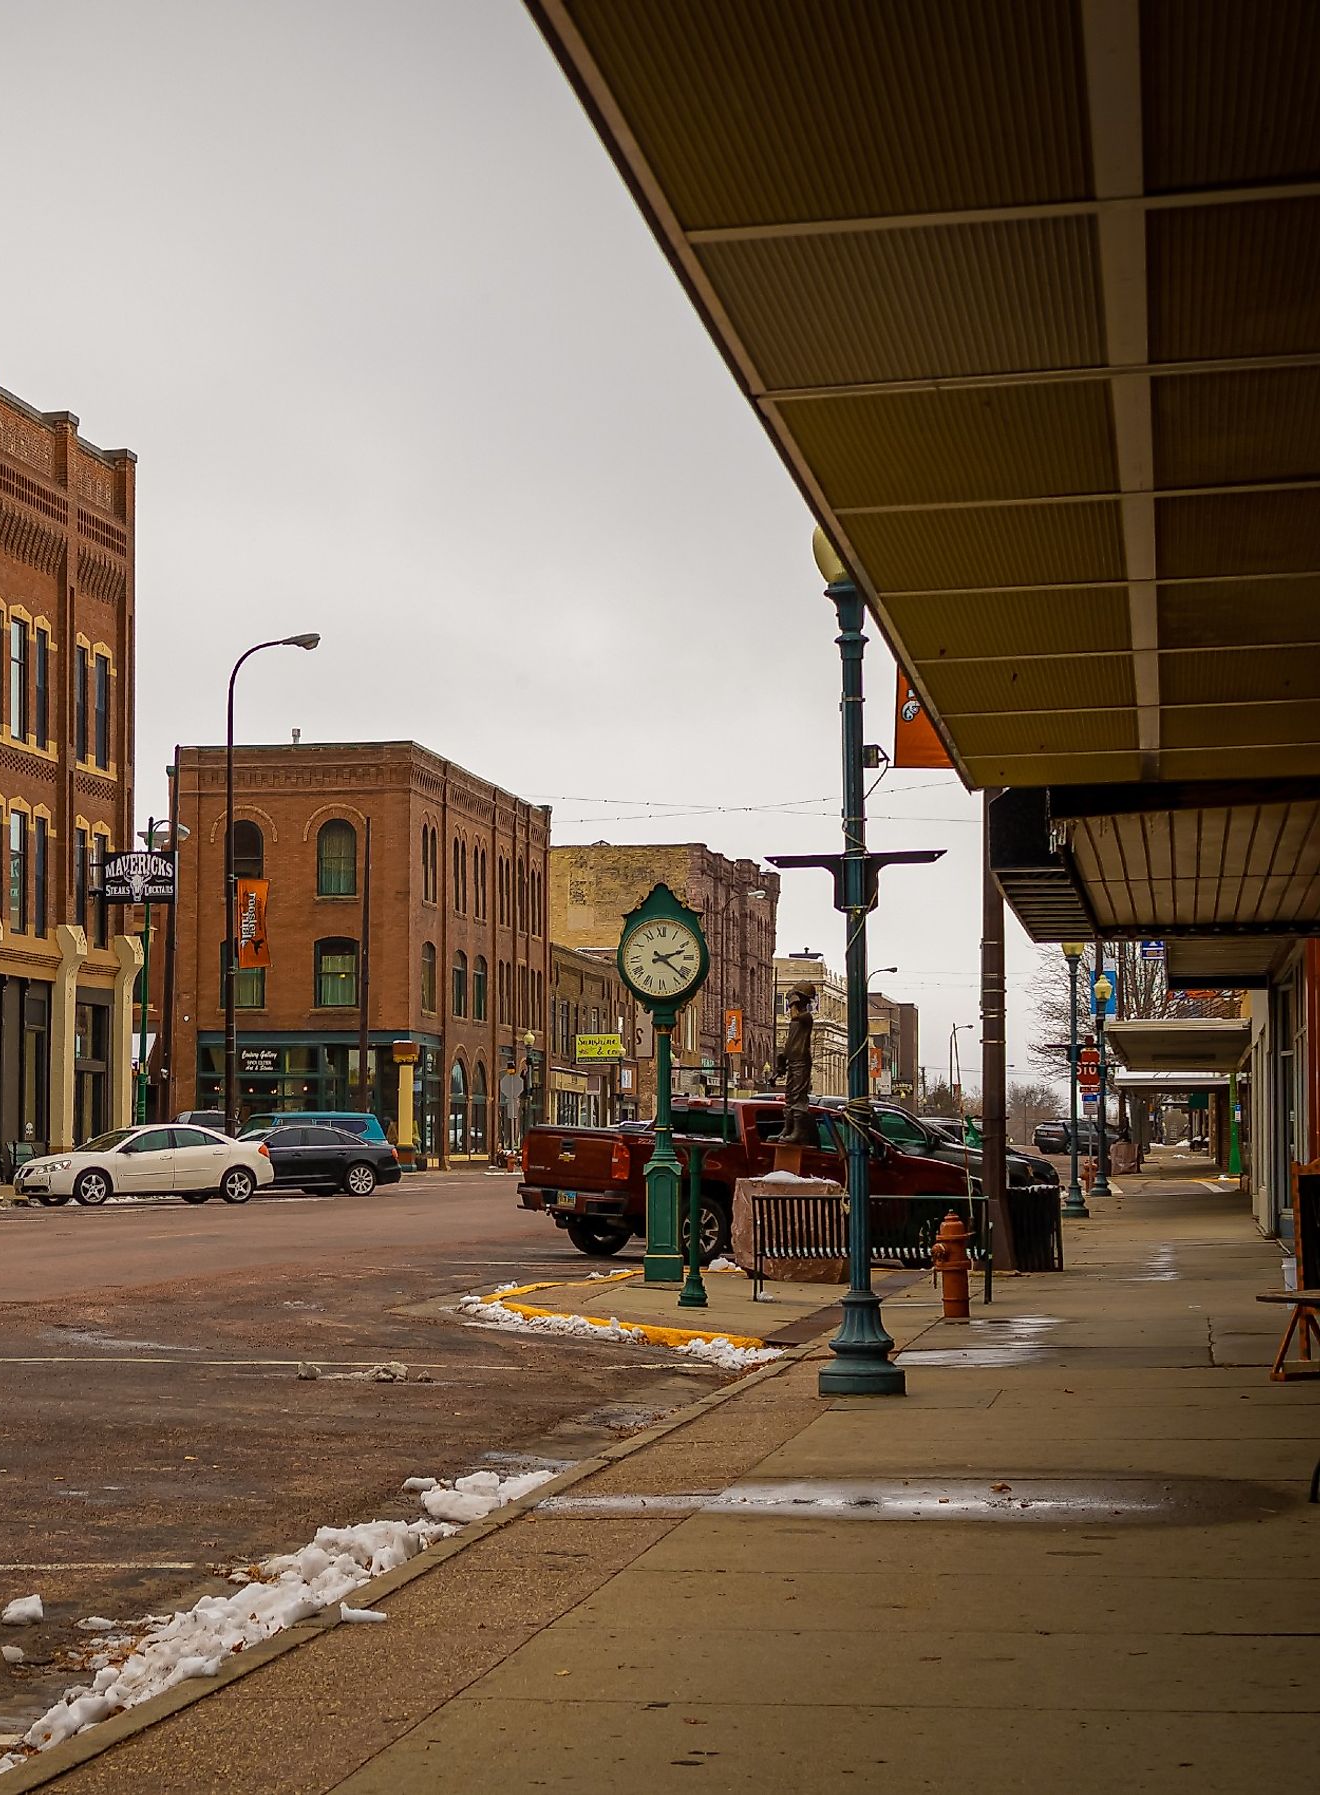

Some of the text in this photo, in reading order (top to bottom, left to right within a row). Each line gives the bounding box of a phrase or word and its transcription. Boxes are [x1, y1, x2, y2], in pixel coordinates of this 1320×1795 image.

[105, 853, 174, 878] MAVERICKS
[105, 884, 130, 896] STEAKS
[1077, 1062, 1098, 1075] STO
